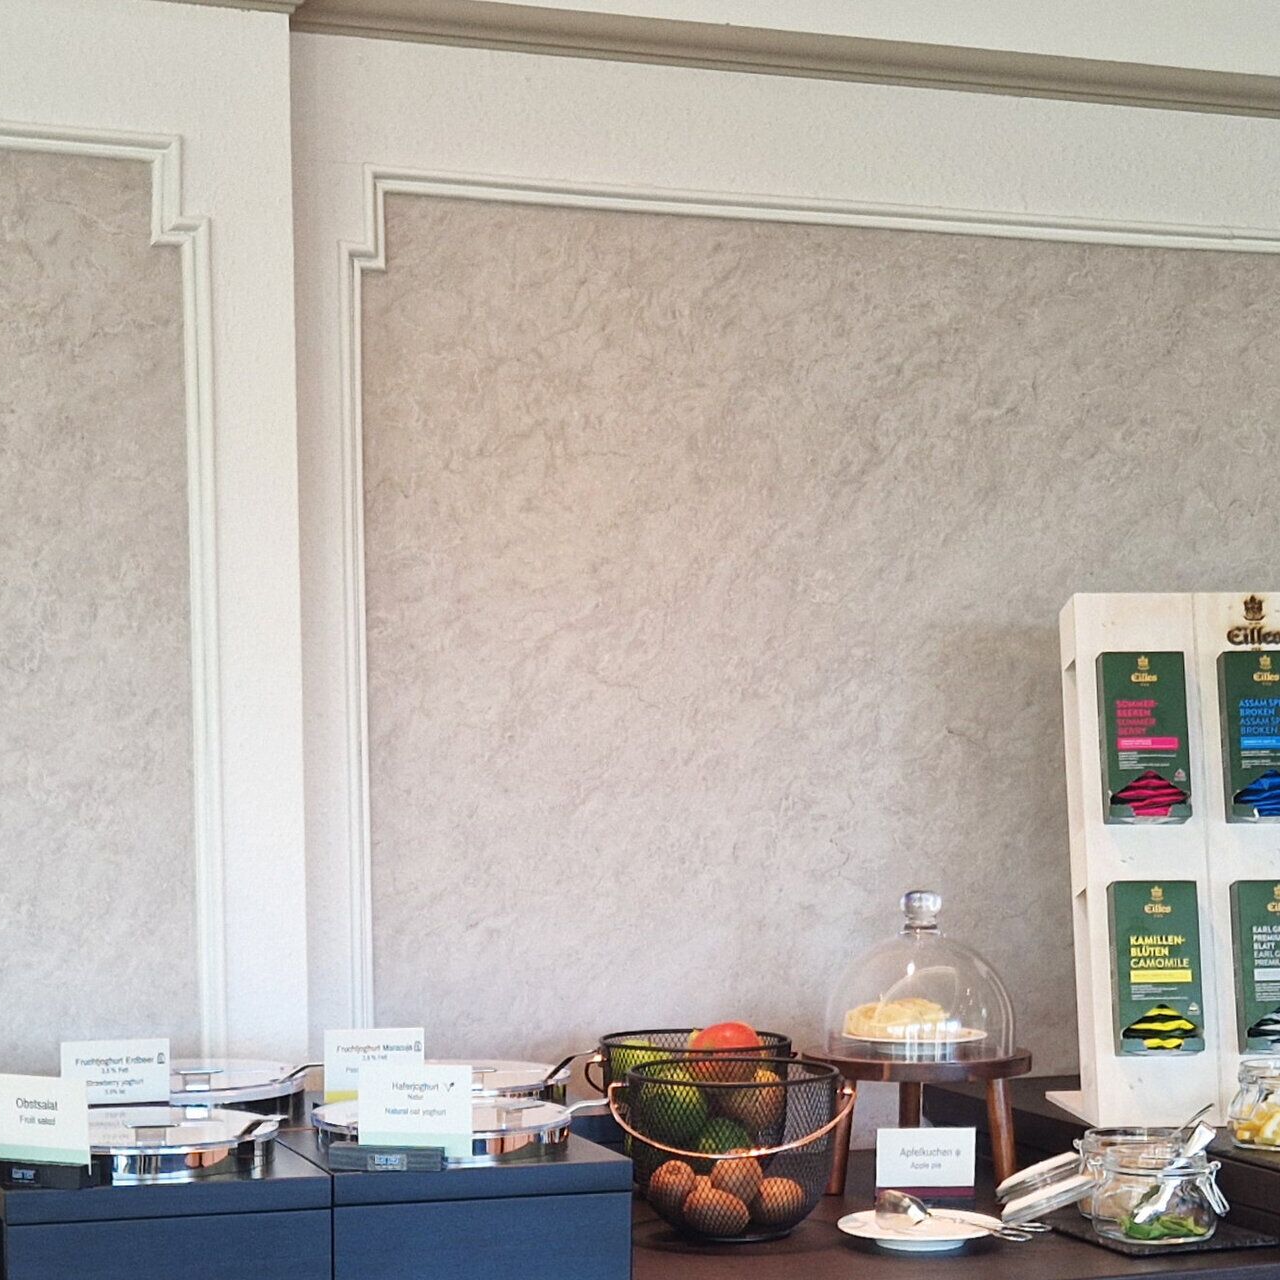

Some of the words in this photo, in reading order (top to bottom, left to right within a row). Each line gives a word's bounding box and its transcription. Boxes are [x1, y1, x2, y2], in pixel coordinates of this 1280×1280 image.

[1239, 700, 1268, 708] ASSAM
[1239, 708, 1275, 716] BROKEN
[1130, 935, 1186, 945] KAMILLEN-
[1131, 946, 1169, 957] BLÜTEN
[1130, 958, 1190, 968] CAMOMILE
[392, 1082, 439, 1092] Haferjoghurt
[15, 1097, 58, 1111] Obstsalat
[19, 1115, 36, 1126] Fruit
[899, 1147, 953, 1159] Apfelkuchen
